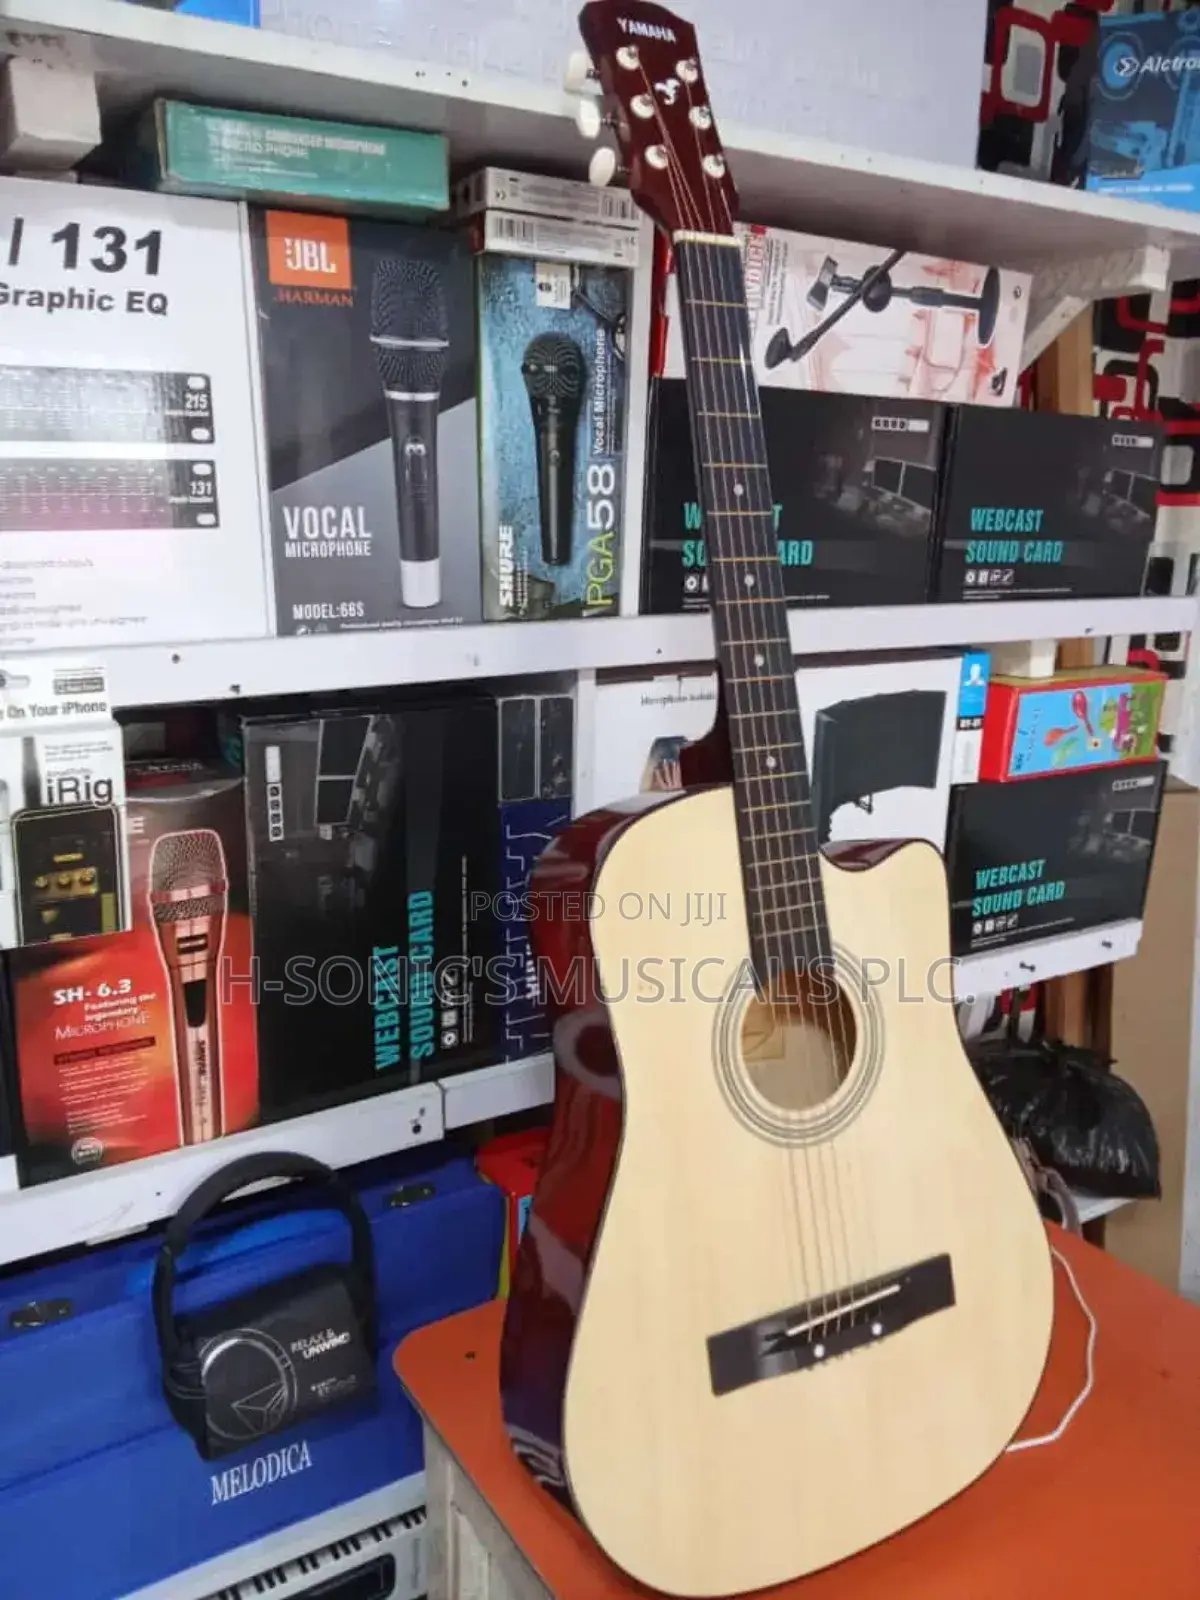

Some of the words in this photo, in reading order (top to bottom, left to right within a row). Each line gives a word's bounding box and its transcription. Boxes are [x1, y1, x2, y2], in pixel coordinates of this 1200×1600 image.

[616, 16, 676, 43] YAMAHA
[1139, 56, 1200, 74] Alctro
[51, 222, 162, 276] 131
[285, 237, 337, 273] JBL
[0, 282, 115, 315] Graphic
[126, 291, 168, 316] EQ
[594, 329, 608, 411] Microphone
[594, 413, 606, 455] Vocal
[282, 506, 372, 540] VOCAL
[587, 463, 615, 606] PGA58
[970, 508, 1044, 532] WEBCAST
[285, 540, 371, 558] MICROPHONE
[500, 524, 514, 607] SHURE
[777, 540, 813, 566] ARD
[965, 541, 1019, 564] SOUND
[1023, 541, 1064, 564] CARD
[7, 705, 25, 719] On
[29, 703, 58, 718] Your
[62, 701, 107, 716] iPhone
[47, 774, 112, 806] iRig
[975, 859, 1046, 890] WEBCAST
[971, 889, 1022, 918] SOUND
[1026, 881, 1065, 906] CARD
[408, 890, 433, 957] CARD
[97, 979, 131, 998] 6.3
[373, 946, 400, 1070] WEBCAST
[408, 970, 434, 1061] SOUND
[211, 1440, 313, 1506] MELODICA
